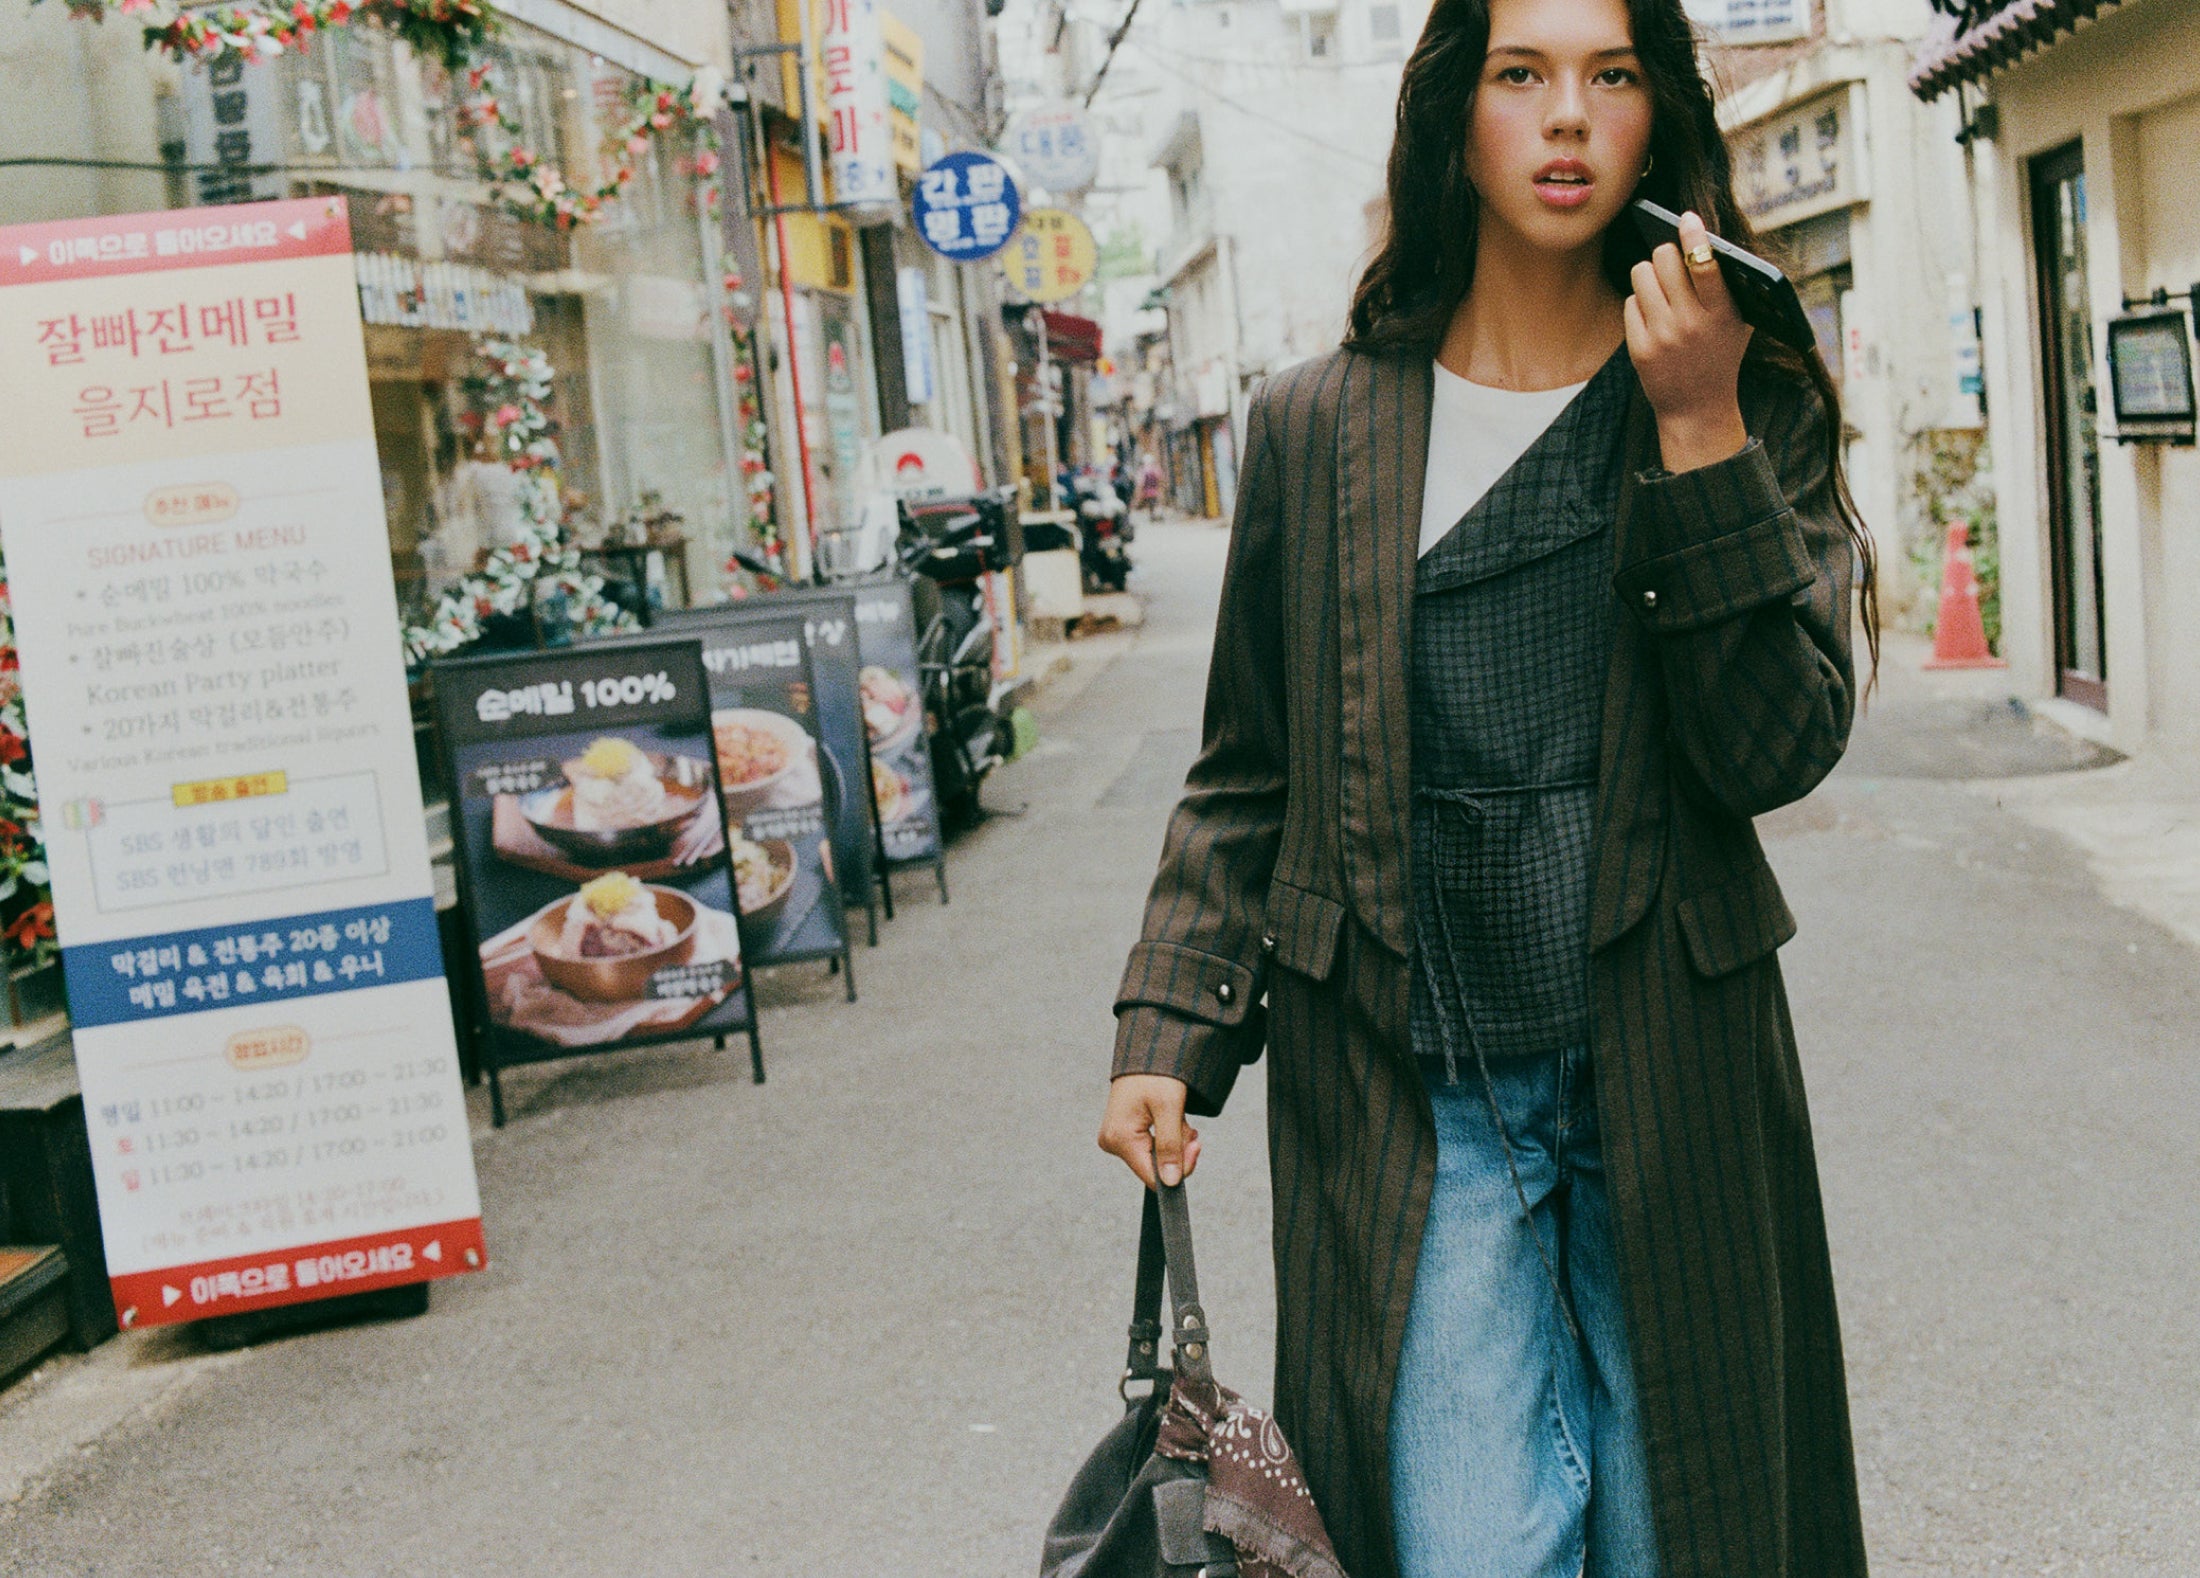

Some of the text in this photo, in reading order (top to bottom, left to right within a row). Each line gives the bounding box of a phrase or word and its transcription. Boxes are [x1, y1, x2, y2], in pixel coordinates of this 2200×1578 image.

[50, 221, 279, 267] 이쪽으로 들어오세요
[37, 292, 301, 367] 잘빠진메밀
[73, 368, 282, 438] 을지로점
[87, 525, 306, 570] SIGNATURE MENU
[101, 559, 327, 607] 순메밀 100% 막국수
[94, 633, 215, 671] 잘빠진술상
[88, 658, 341, 705] Korean Party platter
[476, 670, 677, 722] 순메밀 100%
[103, 710, 180, 742] 20가지
[120, 804, 348, 856] SBS 생활의 달인 출연
[116, 868, 159, 892] SBS
[167, 856, 235, 888] 런닝맨
[111, 914, 391, 978] 막걸리 & 전통주 20종 이상
[128, 977, 177, 1010] 메밀
[235, 970, 256, 994] &
[262, 959, 307, 991] 육회
[312, 959, 335, 983] &
[338, 950, 384, 981] 우니
[102, 1098, 141, 1128] 평일
[150, 1094, 205, 1118] 11:00
[233, 1079, 288, 1104] 14:20
[312, 1069, 366, 1093] 17:00
[393, 1058, 447, 1083] 21:30
[145, 1128, 200, 1153] 11:30
[229, 1115, 284, 1140] 14:20
[308, 1104, 362, 1128] 17:00
[121, 1168, 141, 1192] 일
[149, 1162, 204, 1186] 11:30
[233, 1147, 288, 1172] 14:20
[312, 1136, 366, 1161] 17:00
[393, 1123, 447, 1149] 21:00
[190, 1241, 415, 1306] 이쪽으로 들어오세요
